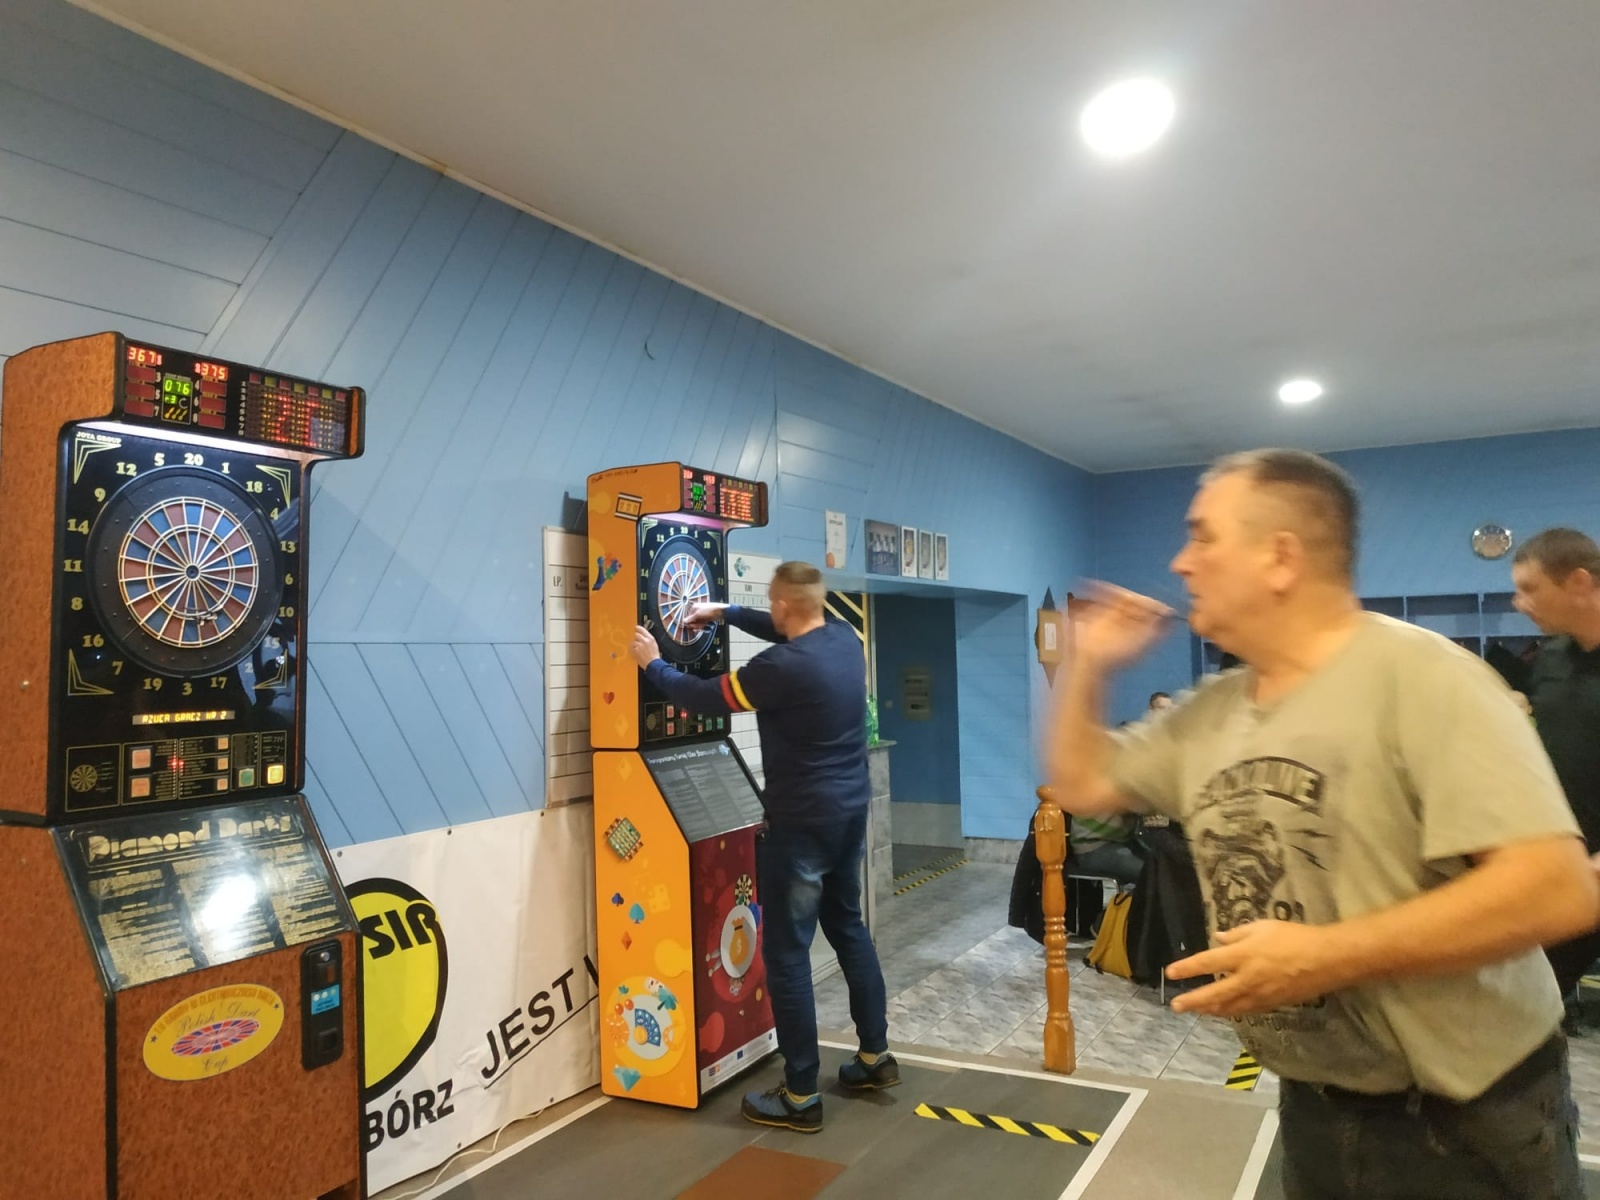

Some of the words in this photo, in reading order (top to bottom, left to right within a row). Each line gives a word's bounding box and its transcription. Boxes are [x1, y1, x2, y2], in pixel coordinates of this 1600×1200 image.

[128, 347, 156, 364] 367
[201, 363, 225, 380] 375
[165, 380, 190, 395] 076
[154, 453, 165, 466] 5
[184, 453, 204, 466] 20
[116, 462, 137, 477] 12
[222, 462, 230, 474] 1
[246, 481, 263, 493] 18
[94, 487, 106, 502] 9
[270, 507, 279, 520] 4
[67, 518, 90, 535] 14
[280, 541, 296, 553] 13
[63, 559, 83, 572] 11
[285, 574, 294, 585] 6
[71, 597, 83, 611] 8
[278, 607, 294, 618] 10
[82, 634, 104, 647] 16
[112, 661, 123, 676] 7
[143, 678, 163, 691] 19
[182, 682, 193, 696] 3
[210, 677, 228, 689] 17
[175, 713, 201, 722] GRACZ
[221, 711, 227, 720] 2
[88, 820, 210, 862] Diamond
[218, 814, 292, 838] Darts
[177, 1009, 216, 1036] Polish
[227, 1001, 261, 1018] Dart
[480, 968, 574, 1080] JEST
[203, 1055, 228, 1072] Cup
[367, 1078, 455, 1152] BÓRZ
